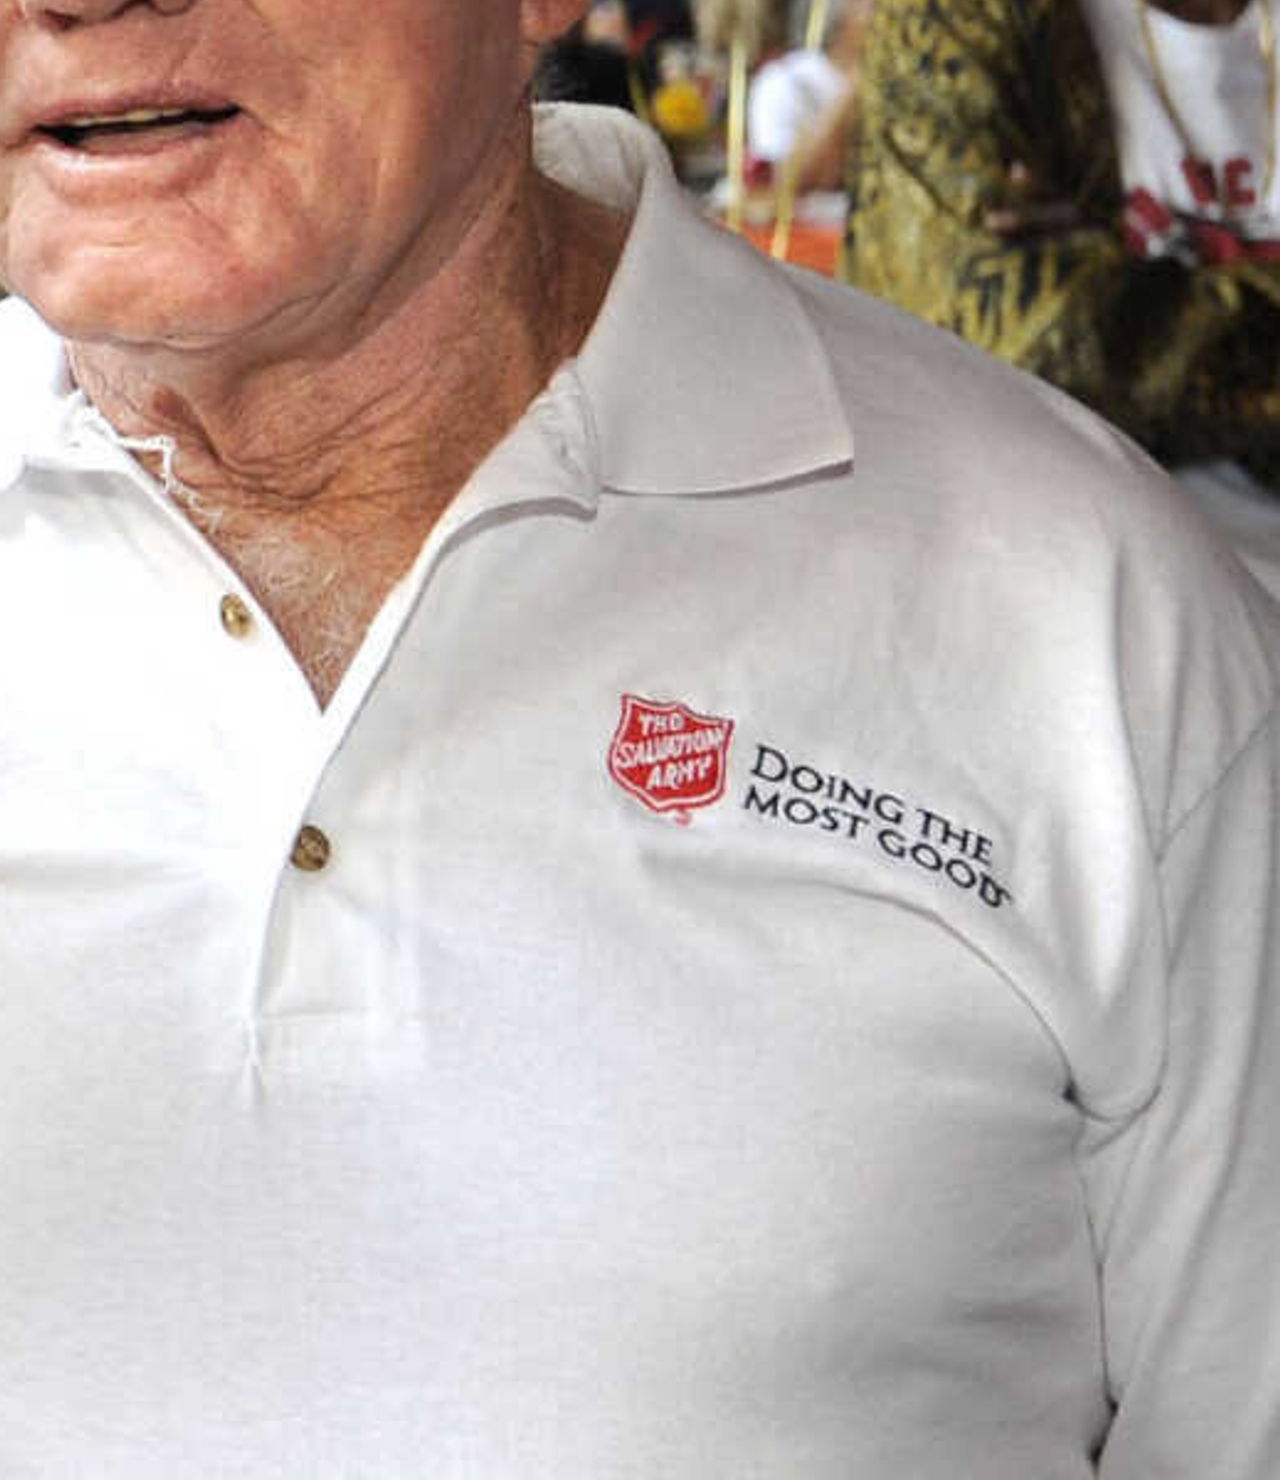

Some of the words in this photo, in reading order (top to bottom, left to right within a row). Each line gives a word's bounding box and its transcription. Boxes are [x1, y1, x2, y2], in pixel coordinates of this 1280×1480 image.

[646, 755, 713, 790] ARMY
[744, 785, 870, 838] MOST
[751, 743, 904, 825] DOING
[916, 807, 993, 866] THE
